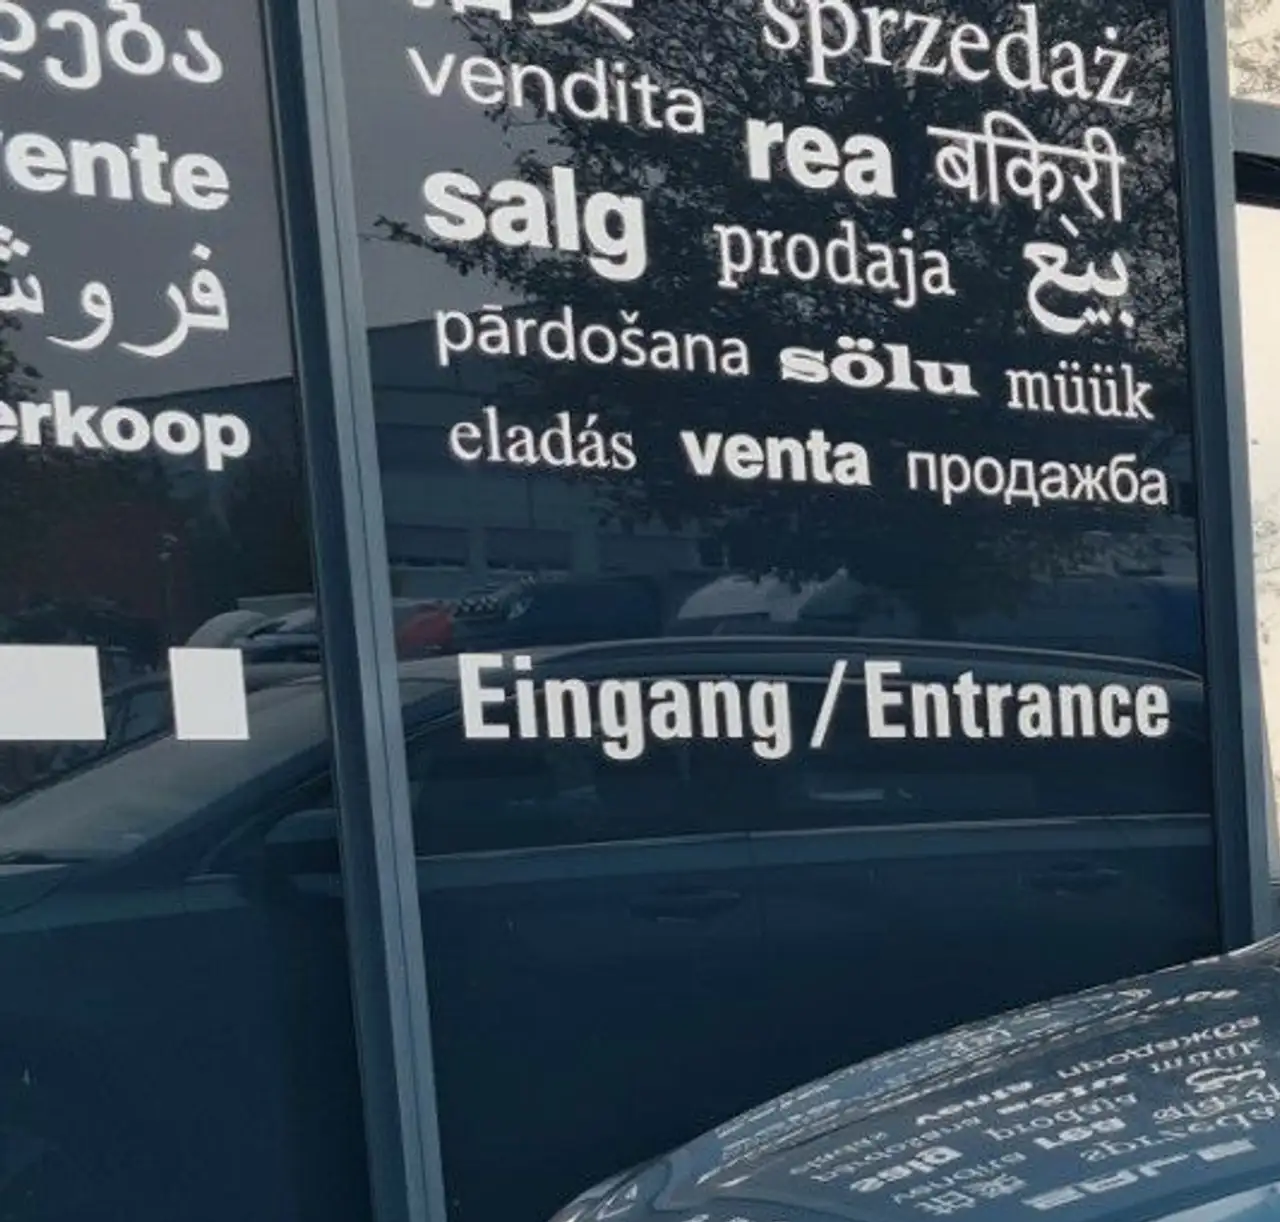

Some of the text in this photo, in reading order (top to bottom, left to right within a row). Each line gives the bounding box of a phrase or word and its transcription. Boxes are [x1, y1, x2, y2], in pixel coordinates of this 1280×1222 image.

[405, 46, 706, 135] vendita
[762, 0, 1135, 107] sprzedaż
[0, 131, 230, 211] ente
[745, 117, 897, 199] rea
[422, 164, 648, 282] salg
[712, 219, 957, 309] prodaja
[434, 303, 1156, 421] pārdošana sölu müük
[448, 405, 872, 487] eladás venta
[906, 451, 1169, 508] продажба
